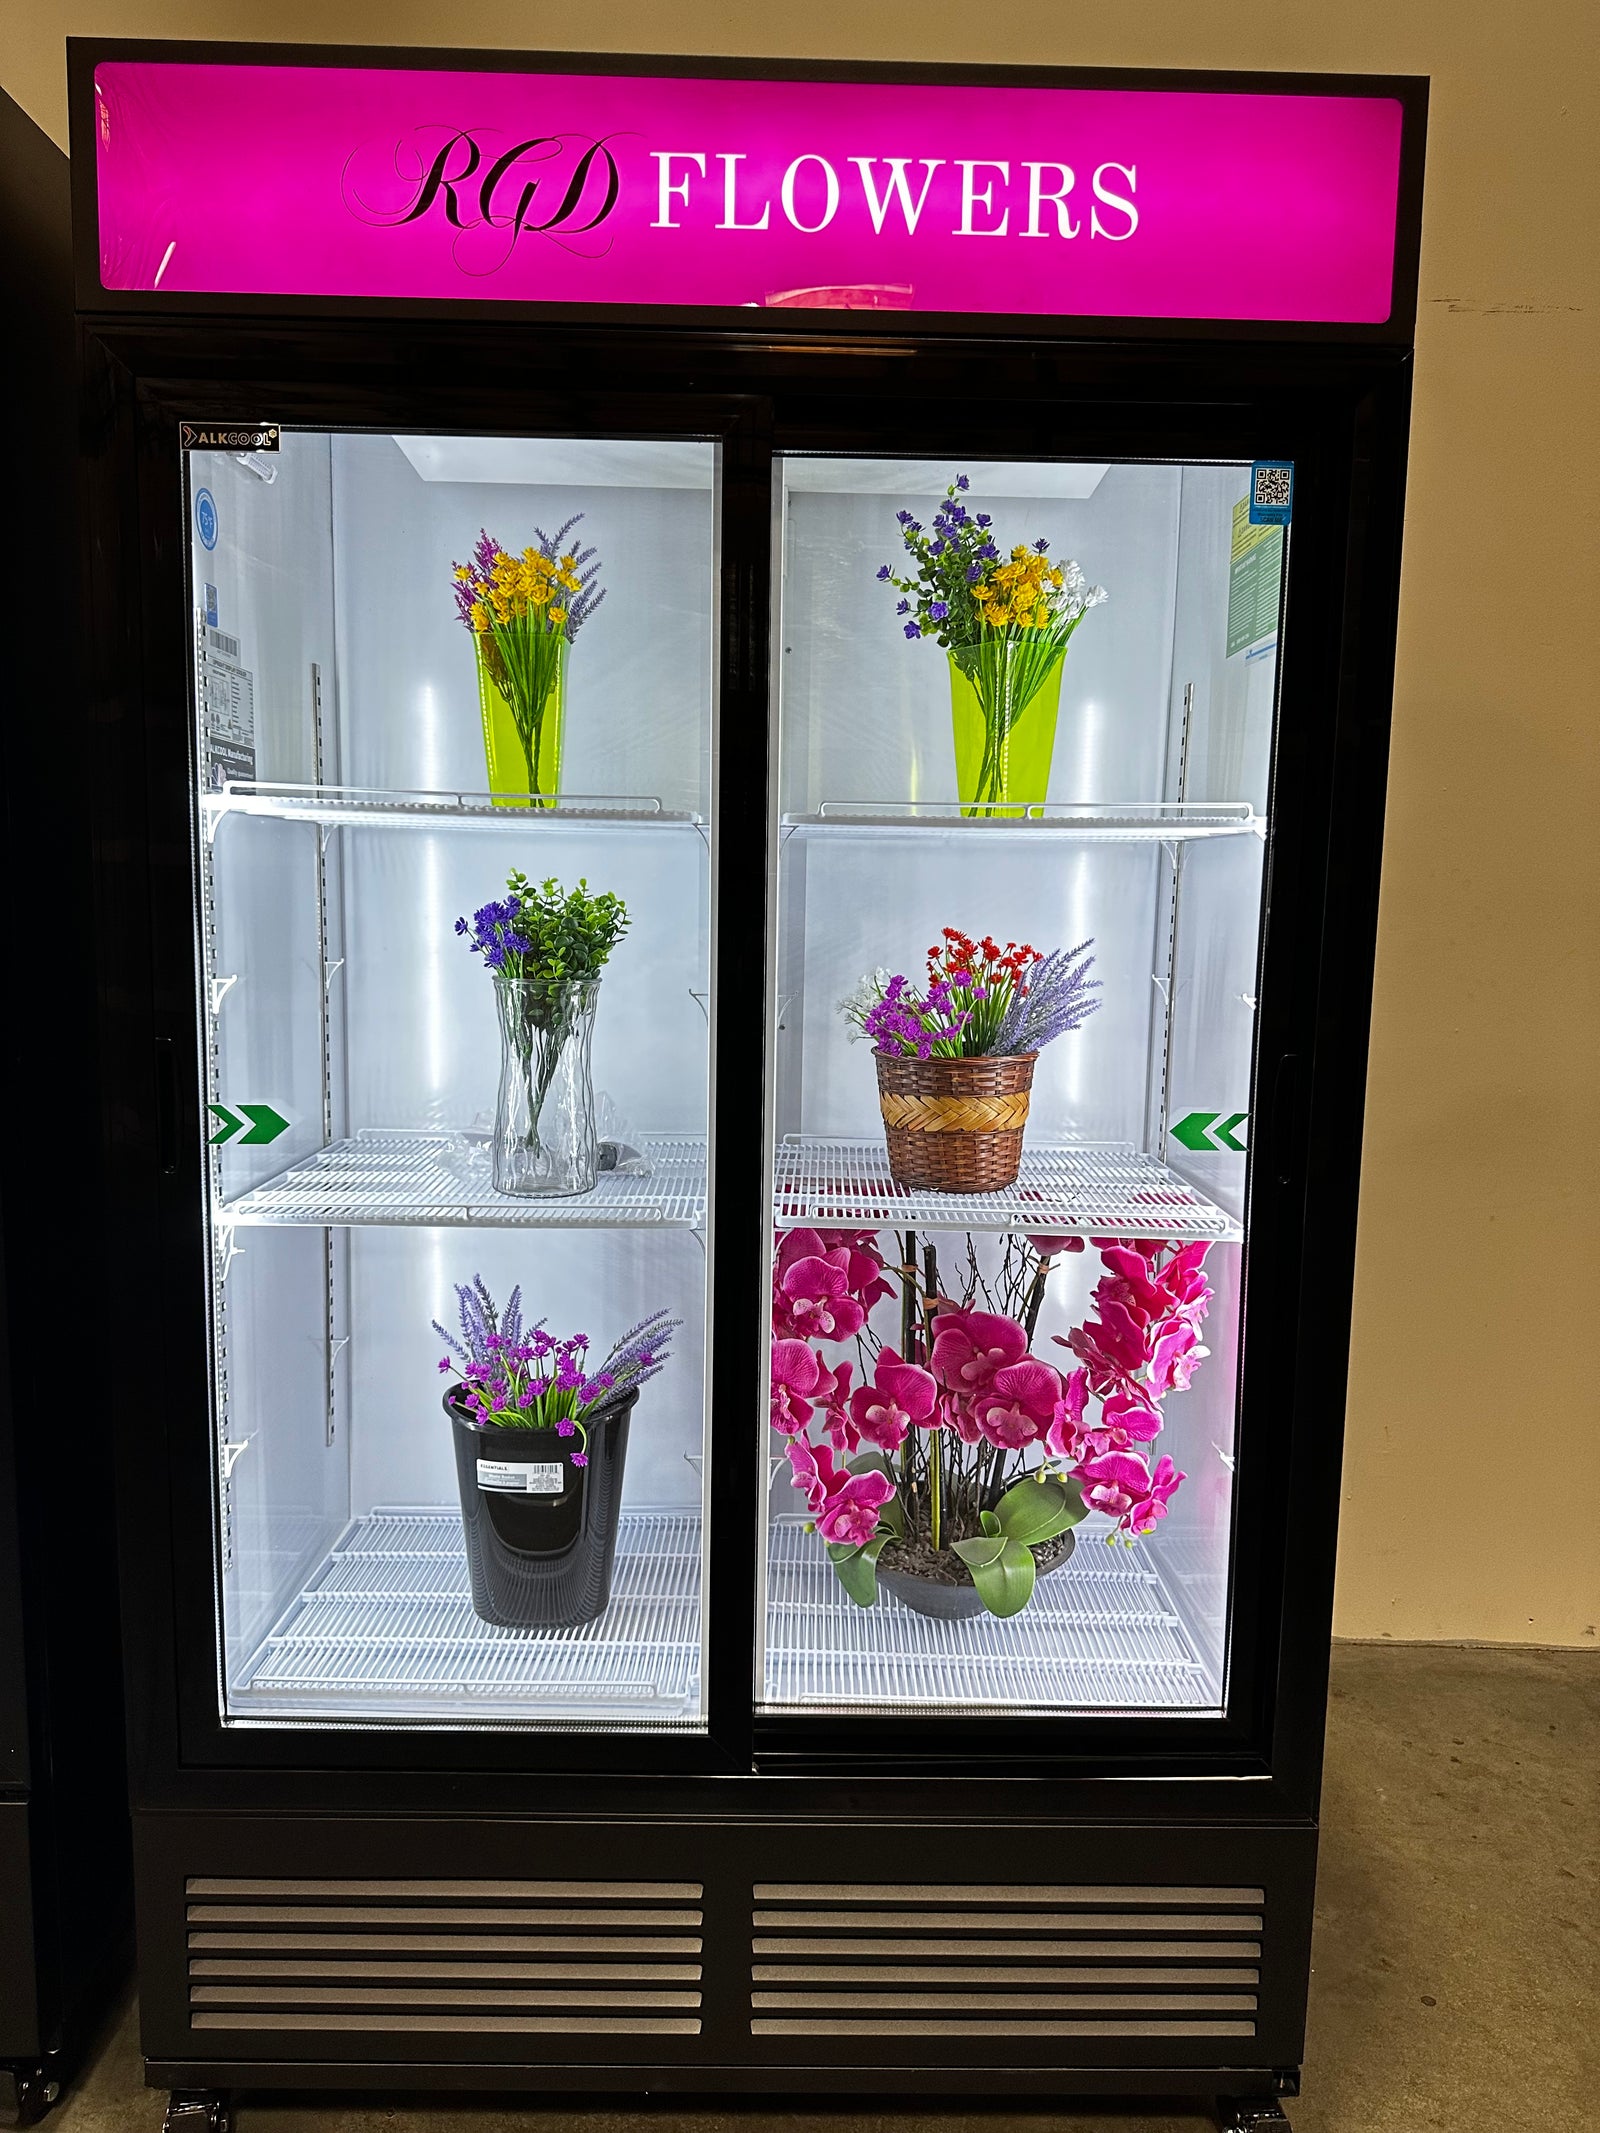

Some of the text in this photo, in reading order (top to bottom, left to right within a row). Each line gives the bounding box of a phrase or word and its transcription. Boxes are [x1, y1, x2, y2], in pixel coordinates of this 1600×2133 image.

[342, 125, 1140, 276] RGD FLOWERS
[198, 432, 272, 446] ALKCOOL
